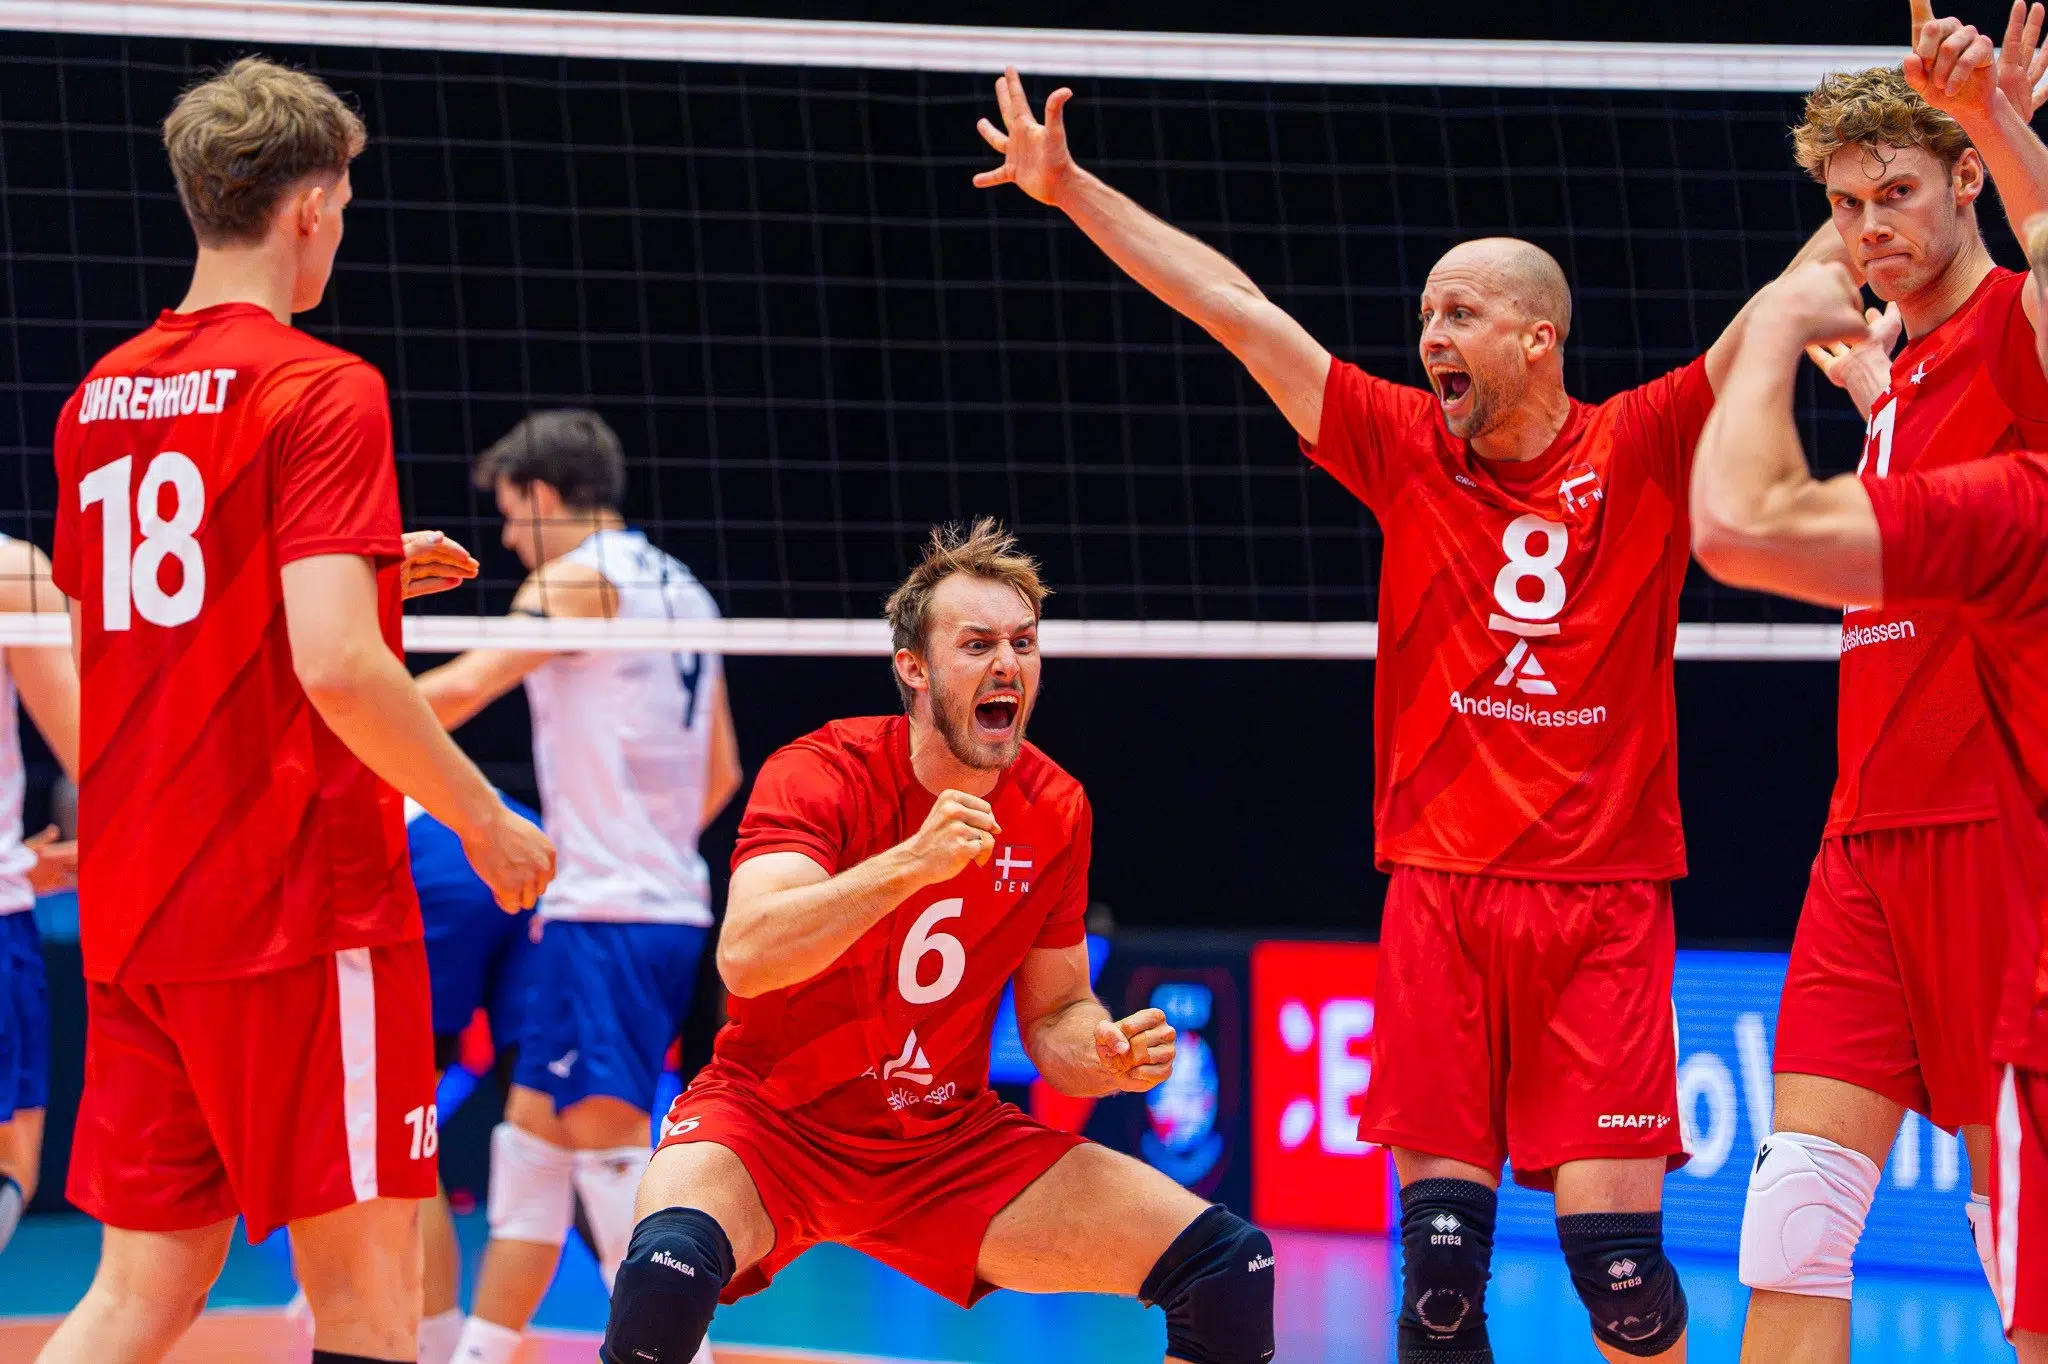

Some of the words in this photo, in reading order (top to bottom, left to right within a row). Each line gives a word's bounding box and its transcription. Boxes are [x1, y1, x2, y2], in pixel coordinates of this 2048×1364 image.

[79, 368, 237, 424] UHRENHOLT
[79, 450, 206, 631] 18
[1494, 513, 1569, 619] 8
[1450, 690, 1607, 727] Andelskassen
[994, 880, 1030, 893] DEN
[898, 897, 966, 1004] 6
[404, 1103, 438, 1160] 18
[668, 1115, 702, 1137] 6
[1597, 1114, 1655, 1128] CRAFT
[1430, 1233, 1462, 1246] errea
[1611, 1276, 1642, 1291] errea
